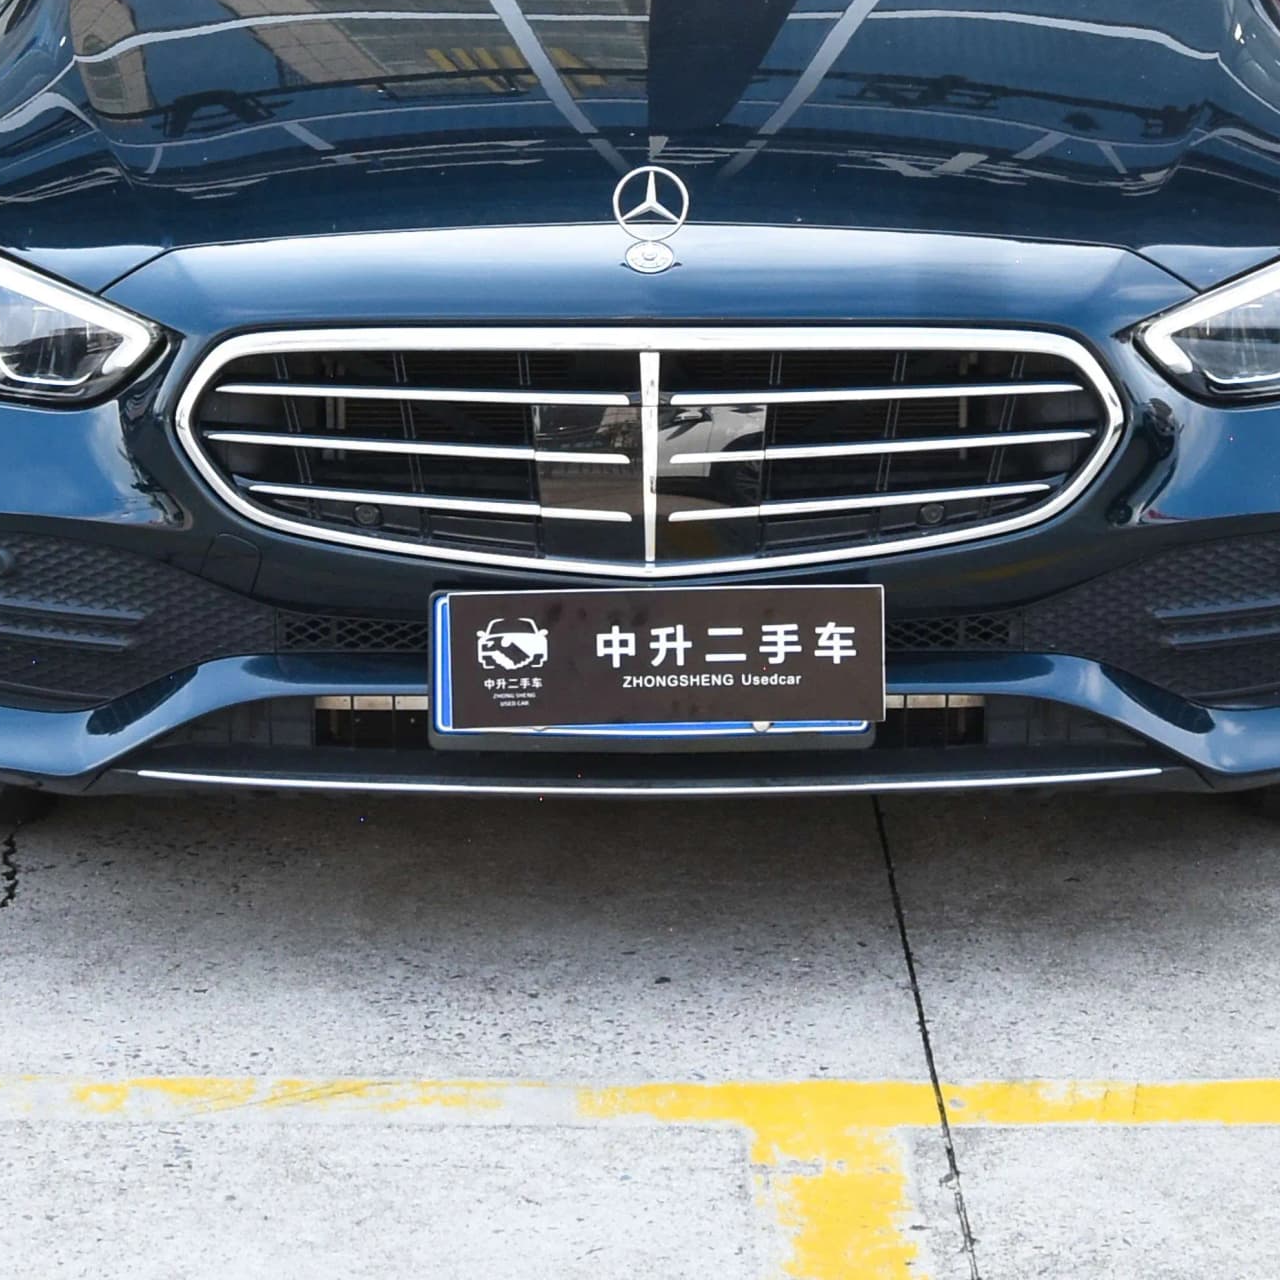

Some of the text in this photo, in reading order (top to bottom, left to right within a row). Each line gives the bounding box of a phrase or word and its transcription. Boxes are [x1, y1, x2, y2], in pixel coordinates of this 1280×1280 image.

[595, 622, 857, 669] 中升二手车
[483, 677, 543, 690] 中升二手车
[622, 672, 802, 688] ZHONGSHENG Usedcar
